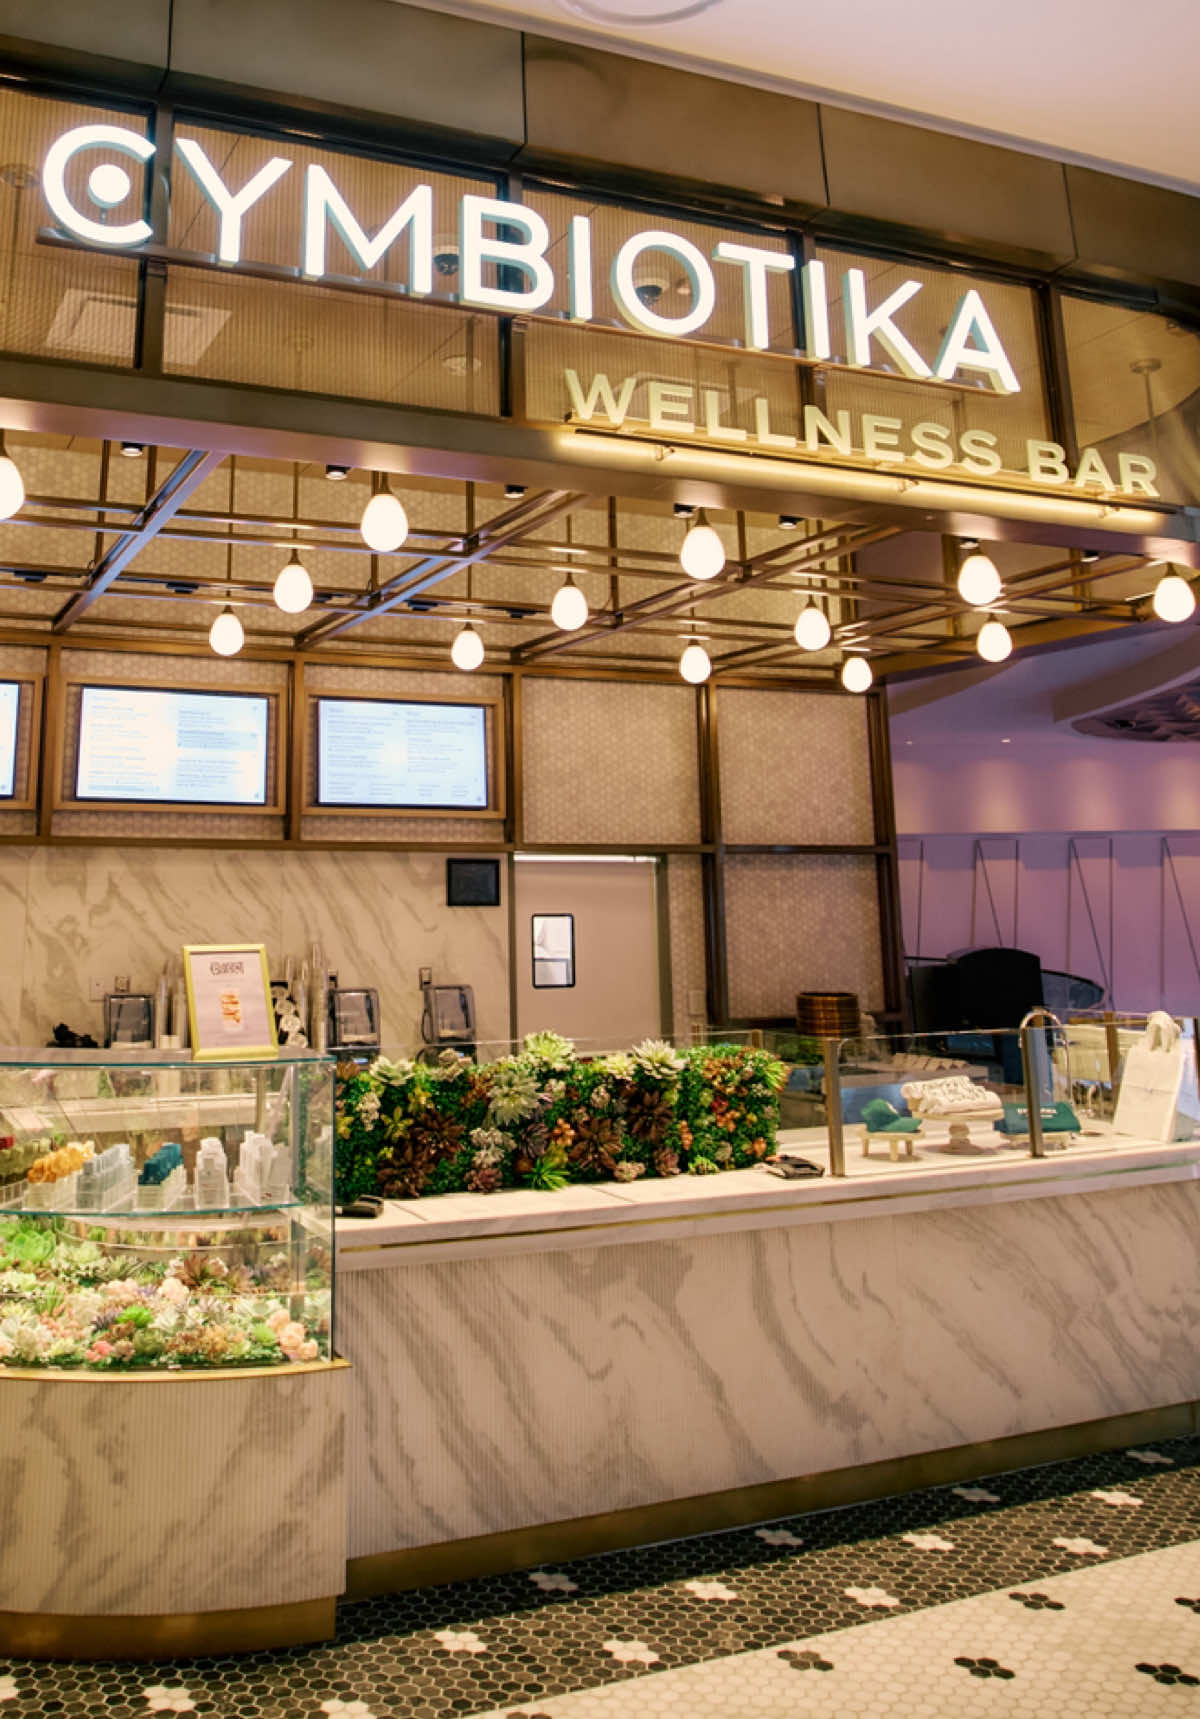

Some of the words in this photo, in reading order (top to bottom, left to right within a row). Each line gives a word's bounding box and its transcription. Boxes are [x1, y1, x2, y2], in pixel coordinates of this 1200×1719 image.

[42, 124, 1021, 394] CYMBIOTIKA
[564, 368, 1002, 476] WELLNESS
[1028, 440, 1160, 497] BAR
